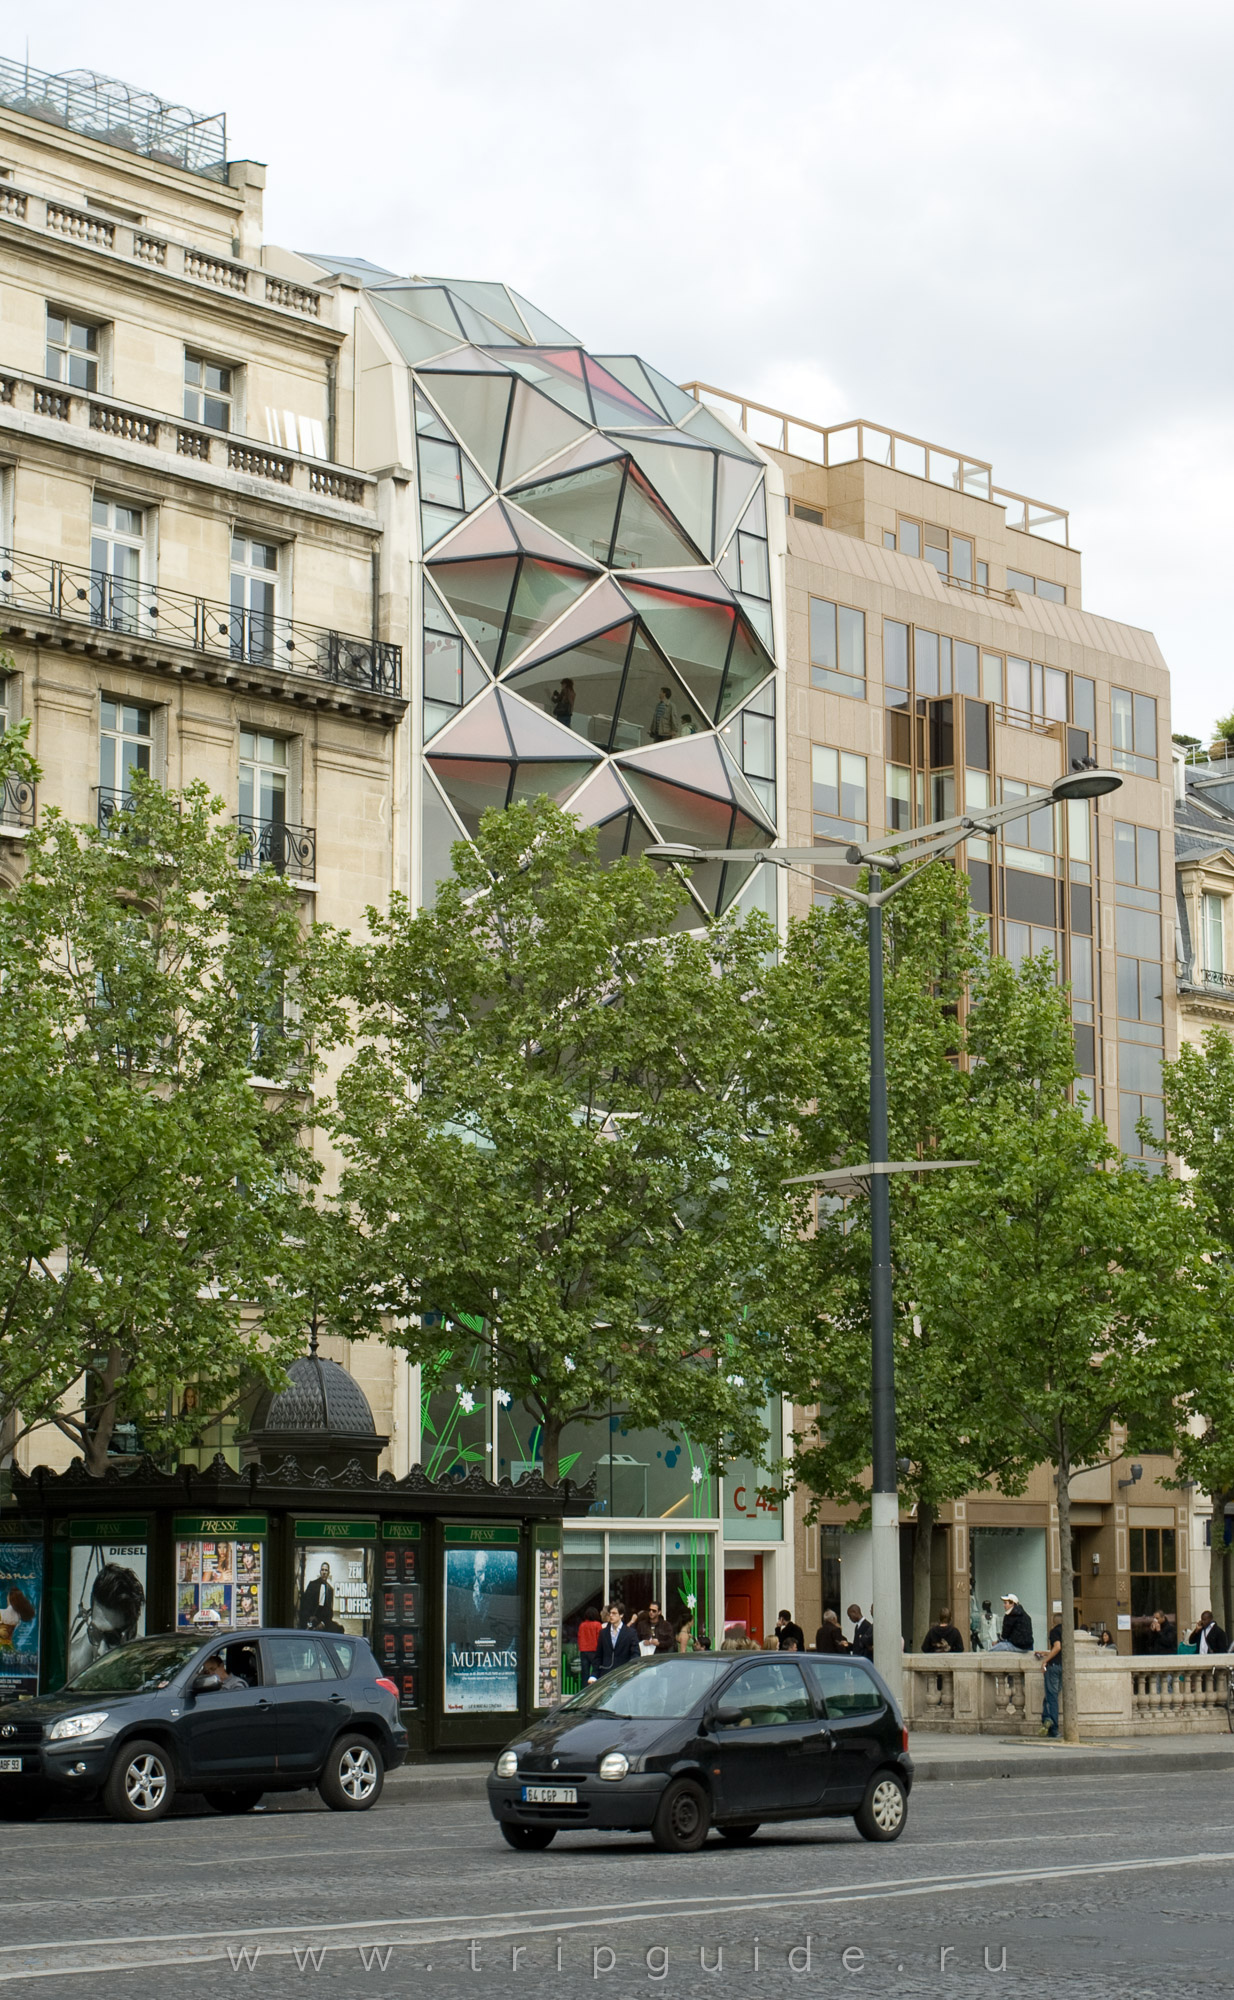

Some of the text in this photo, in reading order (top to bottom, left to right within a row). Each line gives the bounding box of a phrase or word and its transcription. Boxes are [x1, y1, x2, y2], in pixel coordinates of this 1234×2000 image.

[734, 1486, 778, 1518] C_42
[200, 1520, 239, 1533] PRESSE
[323, 1524, 350, 1537] PRESSE
[389, 1525, 415, 1537] PRESSE
[470, 1529, 495, 1542] PRESSE
[109, 1547, 146, 1556] DIESEL
[349, 1566, 362, 1578] ZEM
[334, 1582, 367, 1598] COMMIS
[452, 1651, 517, 1668] MUTANTS
[564, 1790, 574, 1802] 77
